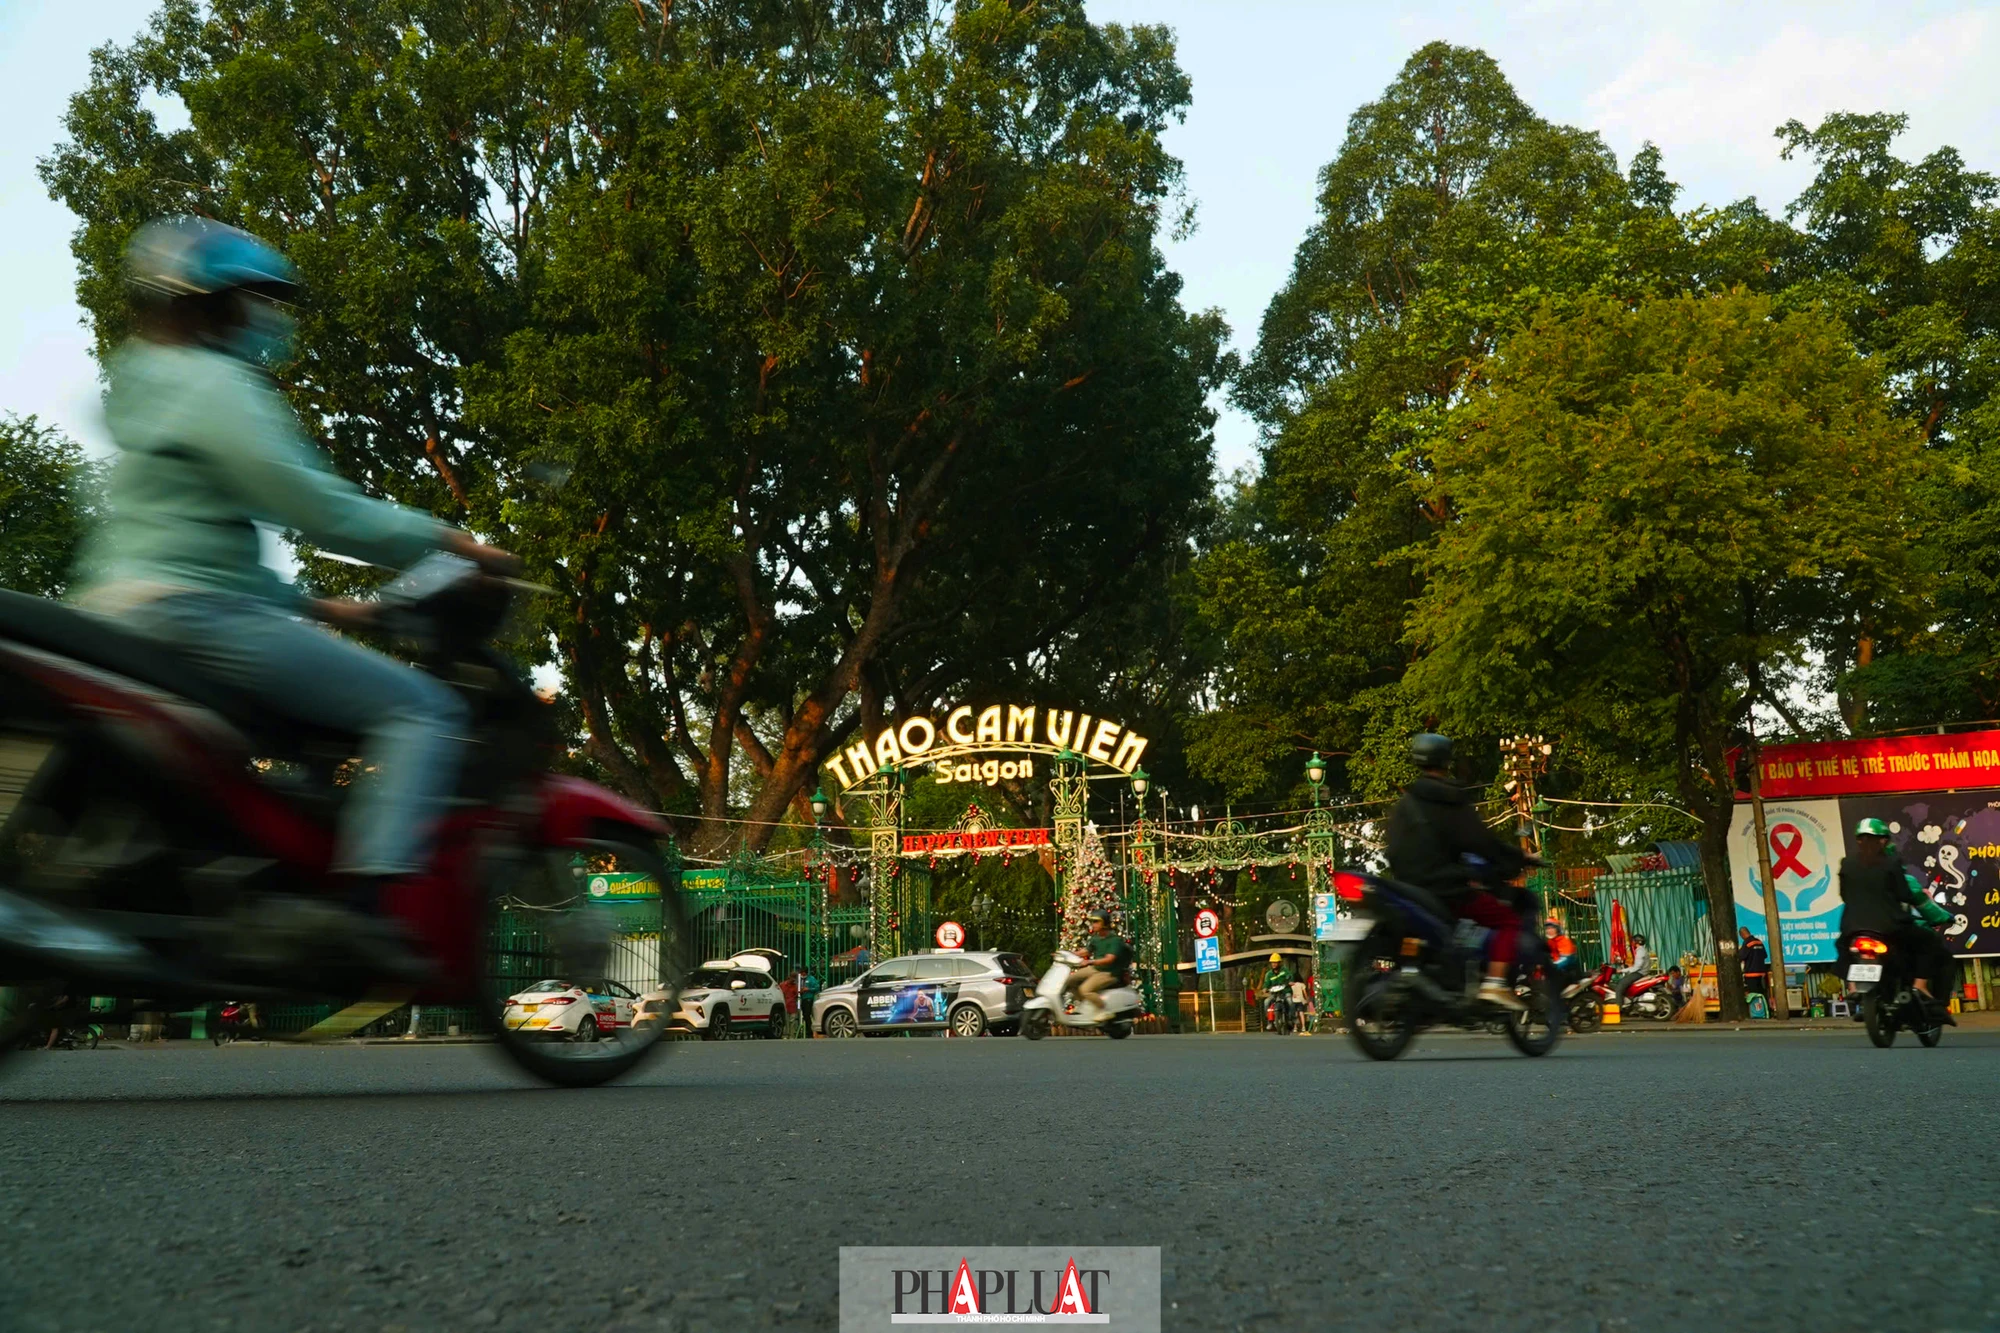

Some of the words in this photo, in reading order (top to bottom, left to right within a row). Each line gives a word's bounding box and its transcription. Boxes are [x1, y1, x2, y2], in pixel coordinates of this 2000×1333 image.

[825, 716, 935, 789] THAO
[947, 704, 1036, 743] CAM
[936, 759, 1033, 786] Saigon
[1768, 758, 1794, 779] BẢO
[1797, 757, 1813, 780] VỆ
[1815, 754, 1839, 777] THẾ
[1842, 755, 1859, 778] HỆ
[1861, 751, 1886, 774] TRẺ
[1888, 751, 1931, 773] TRƯỚC
[1932, 747, 1970, 770] THẢM
[1973, 750, 2000, 770] HỌA
[902, 833, 958, 852] HAPPY
[961, 832, 999, 849] NEW
[1003, 829, 1050, 846] YEAR
